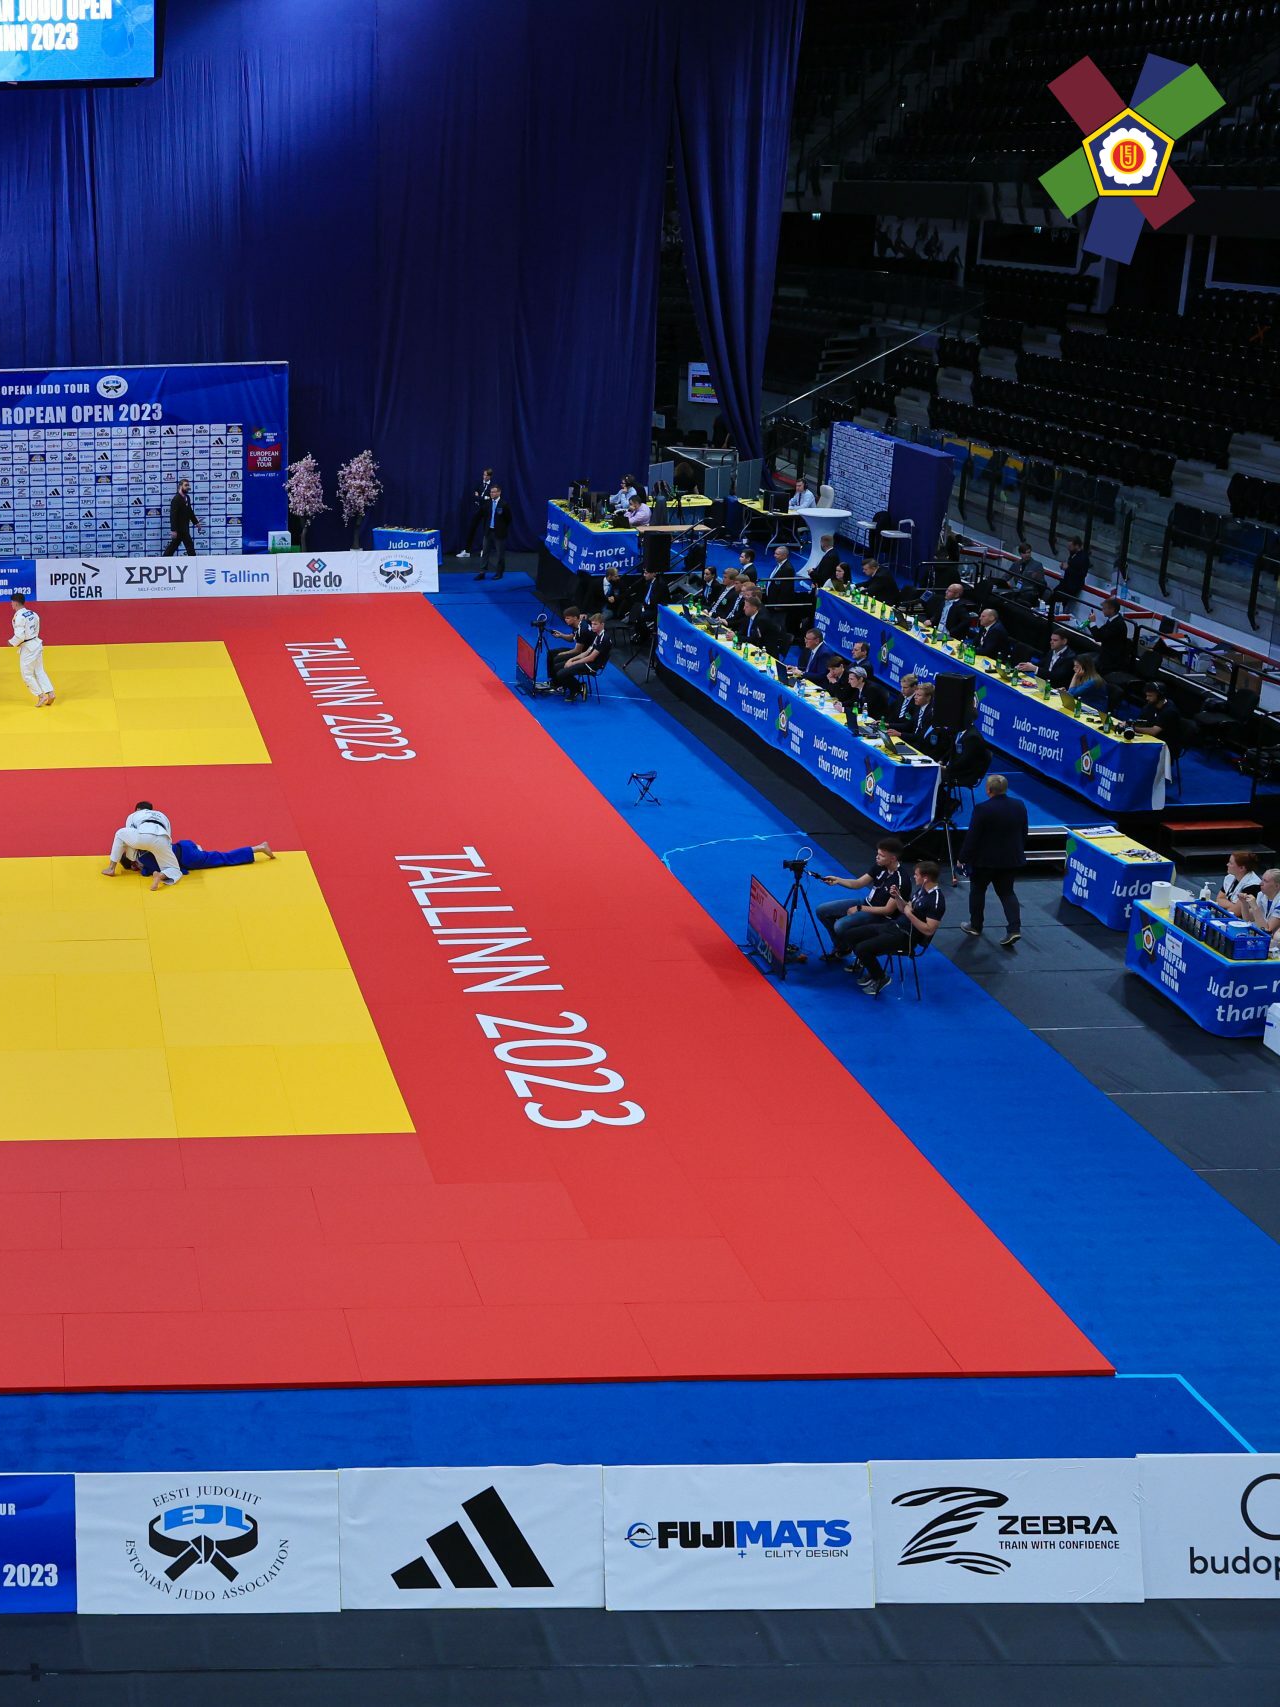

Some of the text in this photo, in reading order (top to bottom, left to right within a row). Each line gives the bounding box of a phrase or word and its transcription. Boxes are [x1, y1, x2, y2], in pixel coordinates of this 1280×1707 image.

[17, 0, 62, 22] JUDO
[66, 0, 112, 21] OPEN
[31, 22, 78, 50] 2023
[36, 383, 61, 395] JUDO
[64, 383, 90, 394] TOUR
[71, 404, 114, 423] OPEN
[119, 403, 163, 421] 2023
[388, 540, 409, 550] Judo
[418, 537, 435, 548] more
[595, 547, 626, 558] more
[50, 572, 86, 586] IPPON
[221, 570, 269, 583] Tallinn
[69, 586, 102, 598] GEAR
[285, 638, 384, 707] TALLINN
[322, 713, 417, 762] 2023
[1012, 716, 1060, 741] Judo more
[813, 735, 848, 762] Judo more
[1018, 737, 1064, 762] than sport!
[832, 764, 852, 782] sport!
[1112, 880, 1151, 897] Judo
[1157, 942, 1187, 974] EUROPEAN
[394, 846, 646, 1129] TALLINN 2023
[1160, 971, 1180, 993] UNION
[1206, 976, 1249, 999] Judo
[152, 1485, 262, 1507] EESTI JUDOLIIT
[657, 1519, 852, 1549] FUJIMATS
[997, 1515, 1118, 1535] ZEBRA
[765, 1550, 801, 1558] CILITY
[806, 1550, 848, 1558] DESIGN
[998, 1540, 1120, 1550] TRAIN WITH CONFIDENCE
[2, 1563, 58, 1588] 2023
[125, 1539, 289, 1600] ESTONIAN JUDO ASSOCIATION
